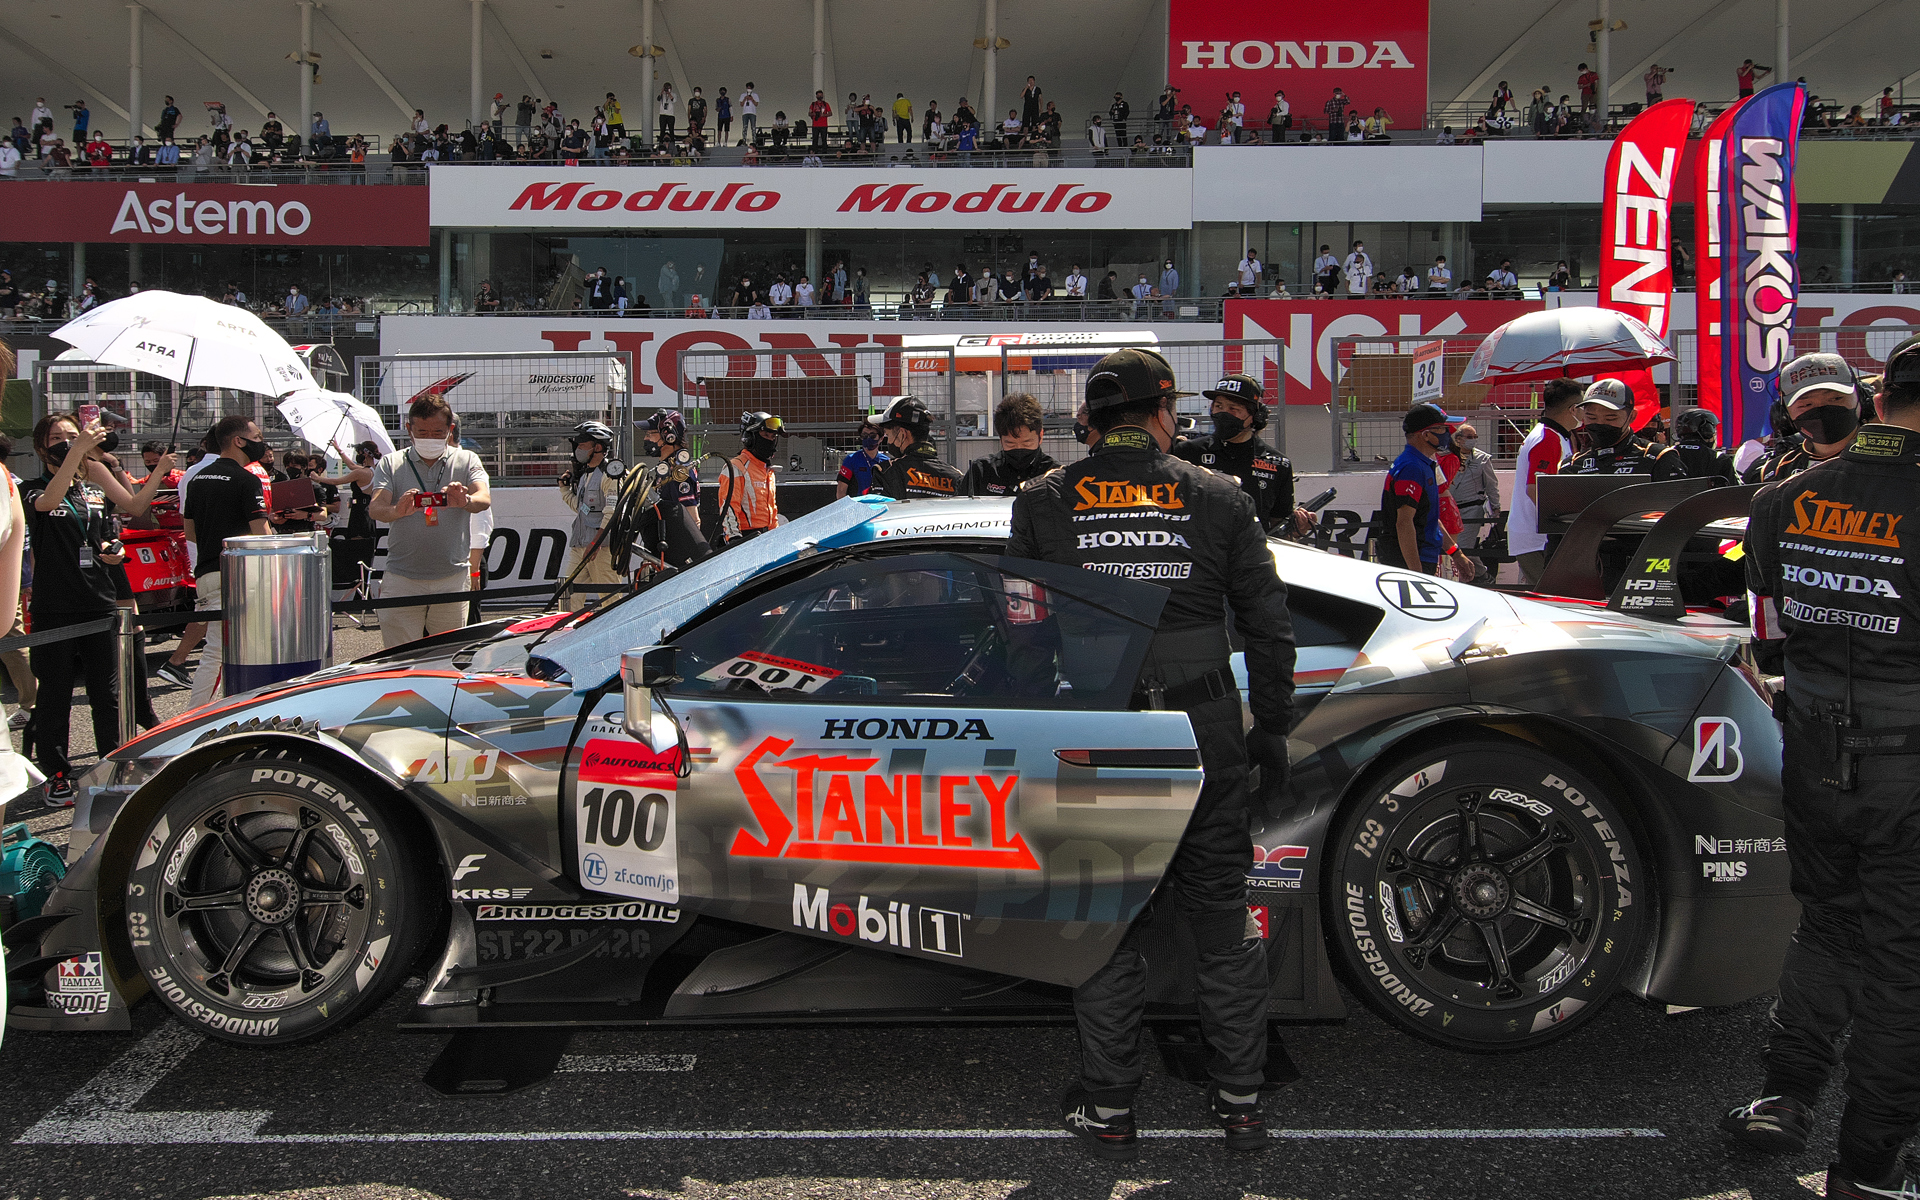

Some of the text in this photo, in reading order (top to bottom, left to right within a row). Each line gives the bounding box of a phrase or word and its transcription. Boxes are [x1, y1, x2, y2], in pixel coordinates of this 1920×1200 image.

[1181, 40, 1415, 69] HONDA
[508, 181, 782, 212] Modulo
[836, 182, 1113, 213] Modulo
[110, 190, 311, 235] Astemo
[1741, 136, 1797, 372] WAKO'S
[914, 359, 939, 370] au
[1243, 312, 1467, 389] NGK
[529, 374, 595, 384] BRIDGESTONE
[536, 383, 585, 395] Motorsport
[1418, 360, 1436, 389] 38
[906, 467, 955, 492] STANLEY
[1073, 476, 1184, 511] STANLEY
[1784, 489, 1903, 548] STANLEY
[1076, 531, 1192, 549] HONDA
[142, 549, 150, 562] 8
[1645, 558, 1671, 573] 74
[1378, 577, 1457, 611] ZF
[1782, 563, 1901, 598] HONDA
[1622, 596, 1655, 607] HRS
[1783, 596, 1901, 634] BRIDGESTONE
[591, 725, 628, 734] OAKL
[820, 718, 994, 741] HONDA
[601, 757, 675, 772] AUTOBACS
[251, 768, 382, 848] POTENZA
[730, 736, 1042, 870] STANLEY
[1380, 793, 1399, 812] 3
[1489, 788, 1553, 816] RAYS
[581, 787, 670, 852] 100
[325, 823, 364, 876] RAYS
[1542, 774, 1633, 908] POTENZA
[164, 828, 198, 885] RAYS
[1703, 861, 1747, 878] PINS
[583, 856, 675, 893] ZF zf.com/jp
[128, 882, 145, 898] 3
[452, 889, 510, 900] KRS
[477, 902, 680, 923] BRIDGESTONE
[792, 882, 911, 949] Mobil
[1346, 882, 1434, 1017] BRIDGESTONE
[61, 978, 102, 987] TAMIYA
[149, 965, 280, 1037] BRIDGESTONE
